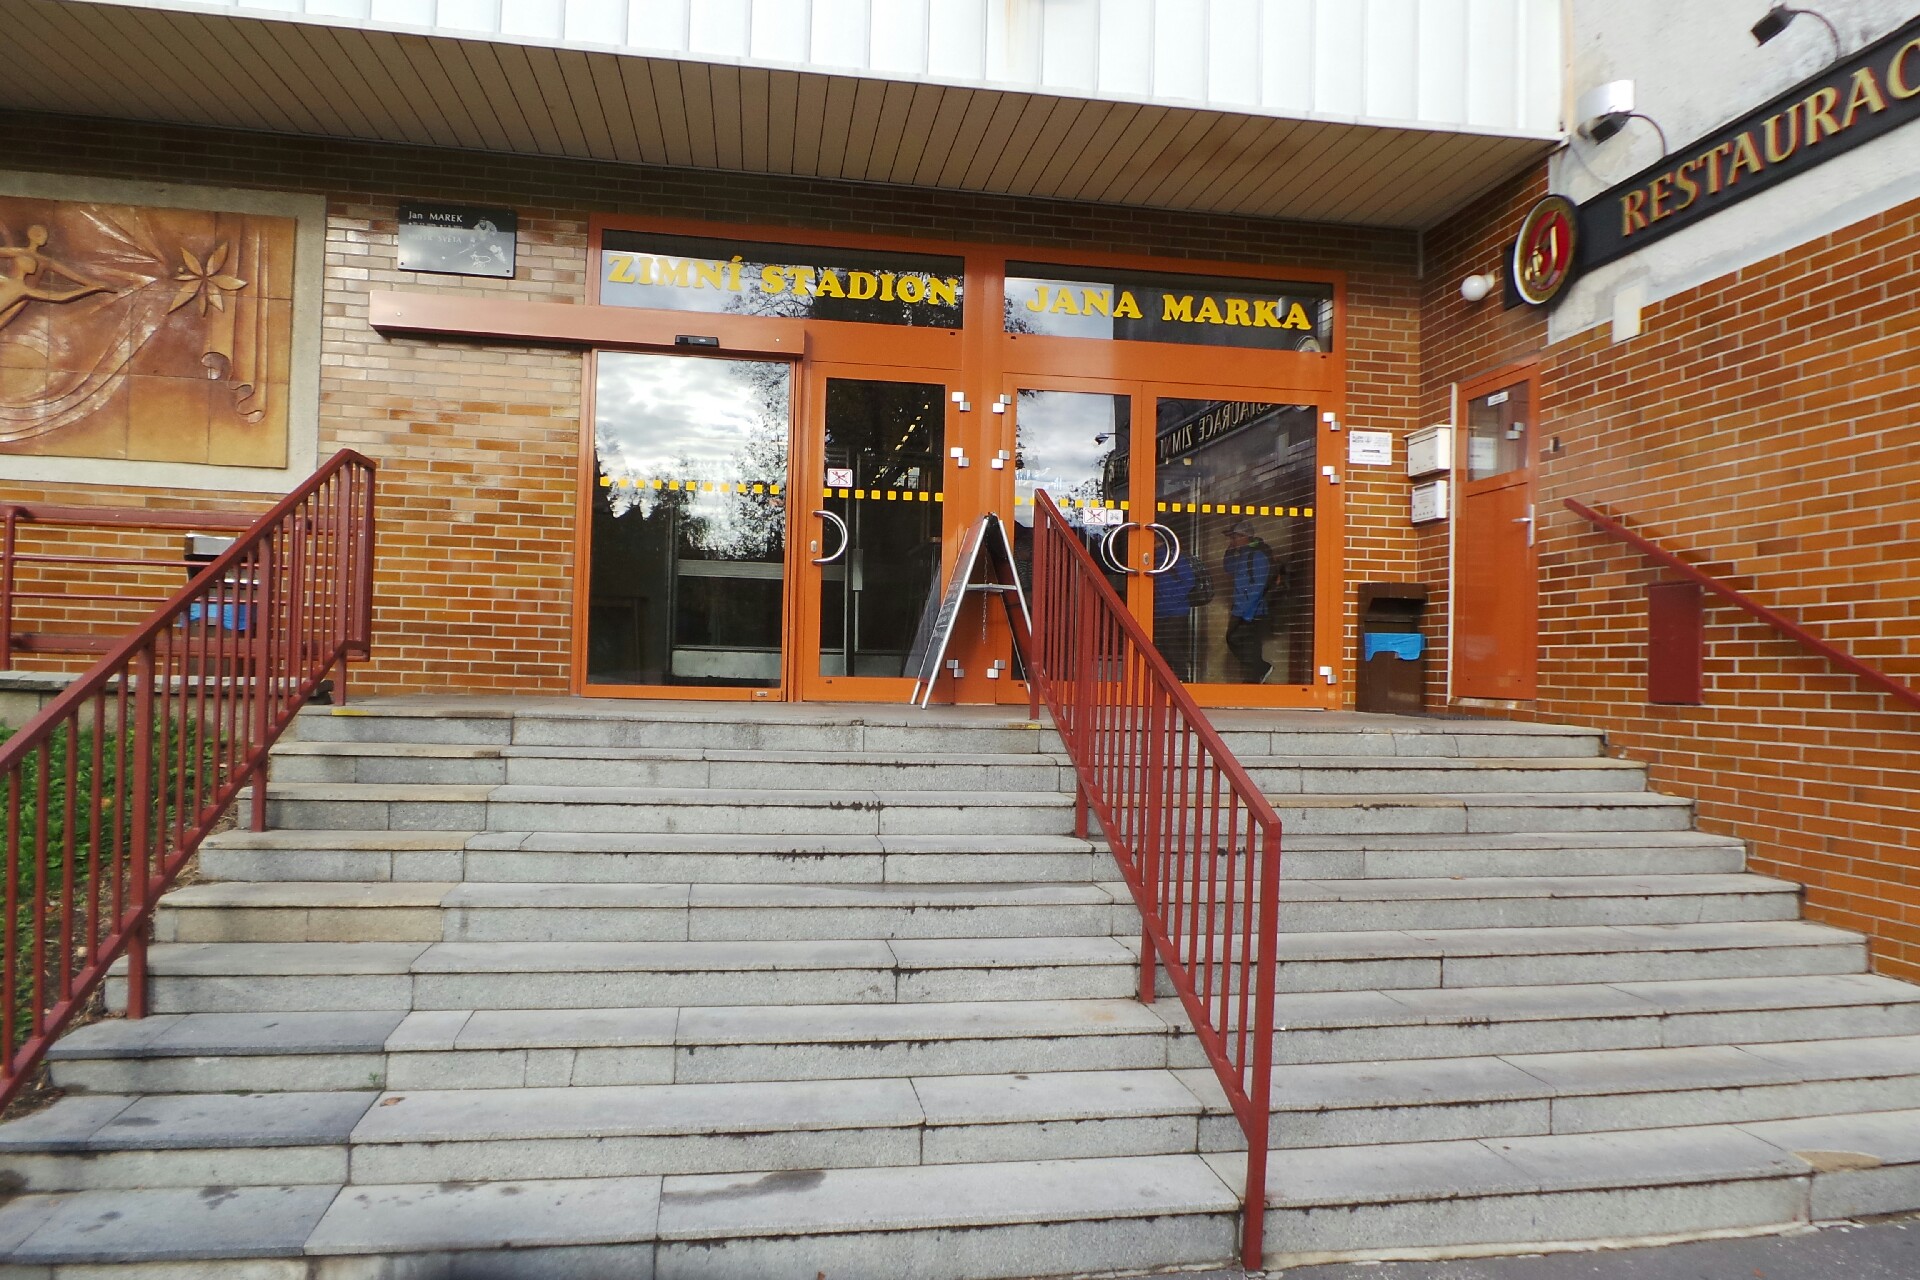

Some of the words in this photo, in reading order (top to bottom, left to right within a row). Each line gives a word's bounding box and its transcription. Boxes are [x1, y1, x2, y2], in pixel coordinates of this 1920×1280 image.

[1619, 38, 1920, 237] RESTAURAC
[408, 211, 422, 220] Jan
[429, 213, 463, 222] MAREK
[607, 255, 743, 292] ZIMNÍ
[761, 265, 959, 306] STADION
[1026, 285, 1143, 319] JANA
[1161, 294, 1313, 331] MARKA
